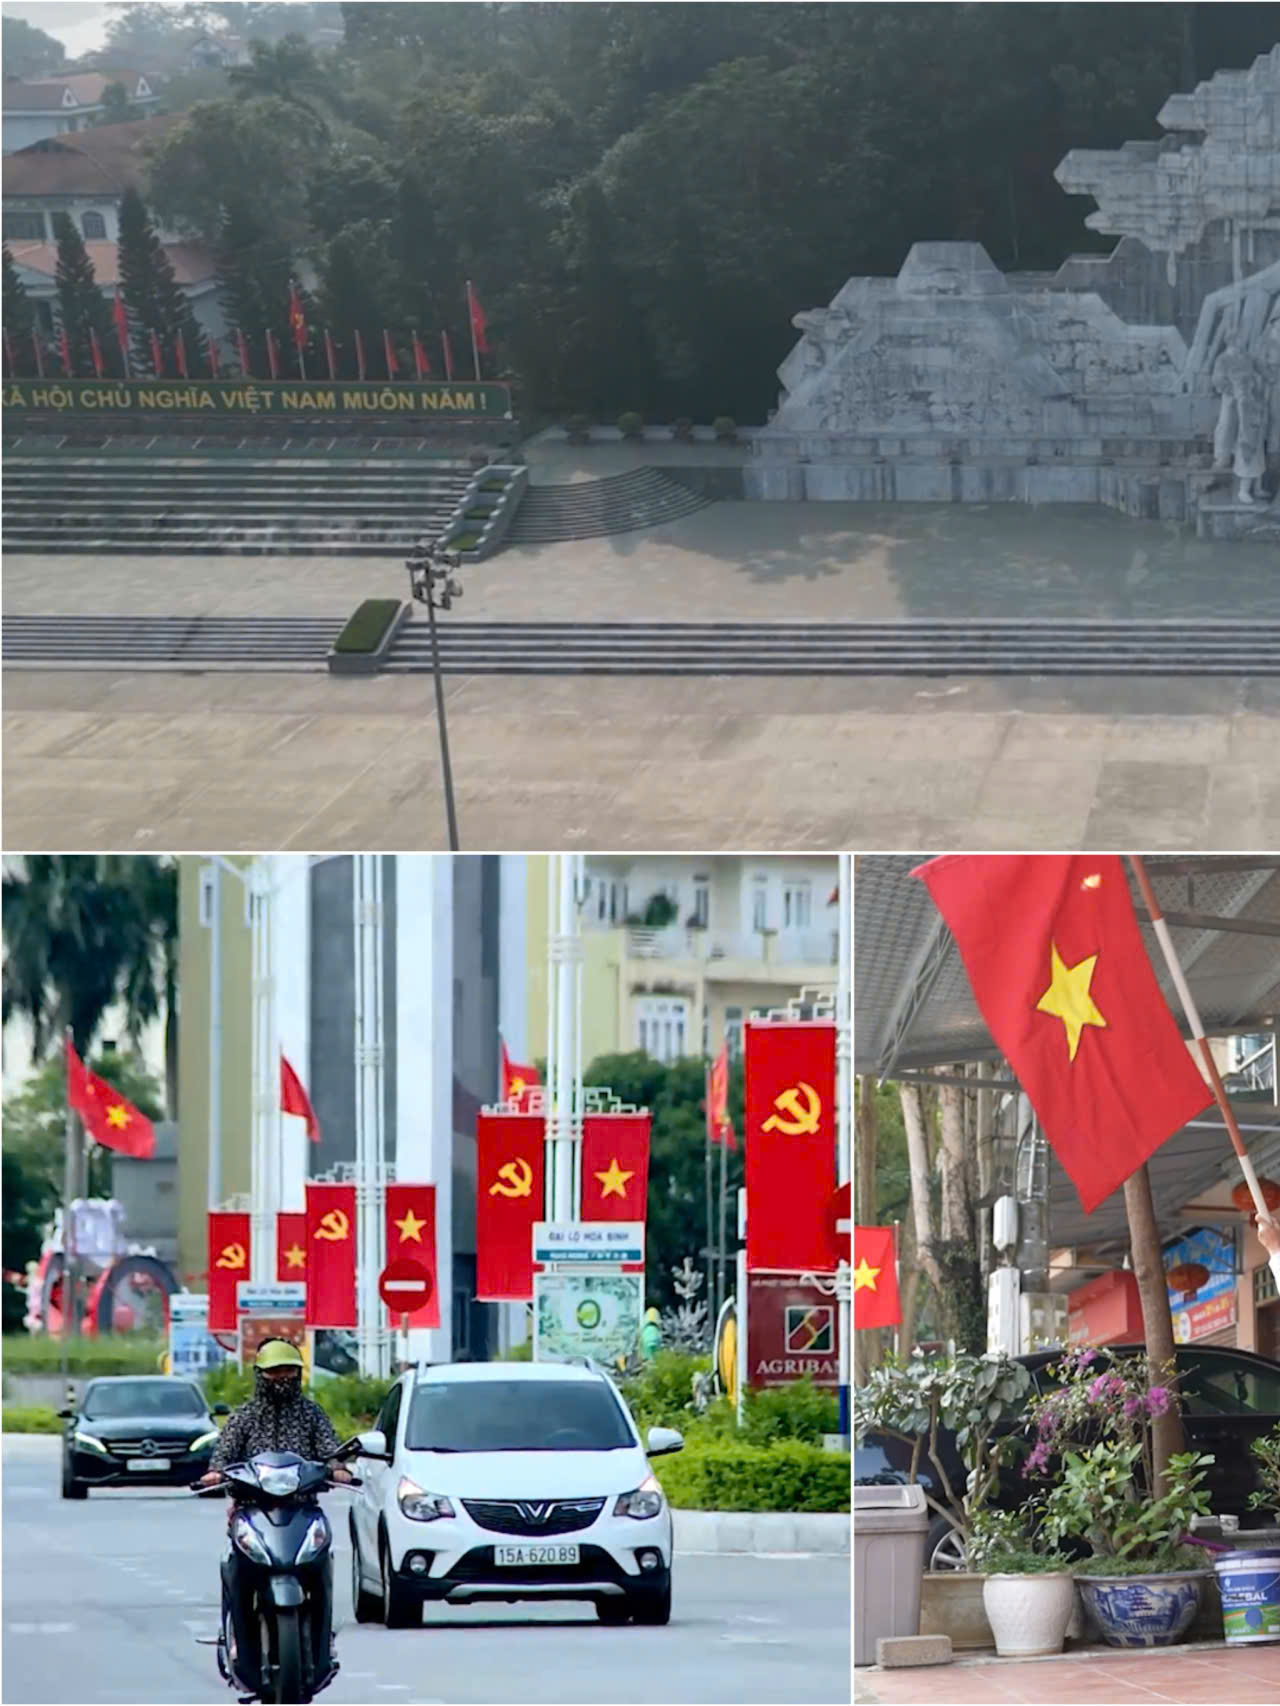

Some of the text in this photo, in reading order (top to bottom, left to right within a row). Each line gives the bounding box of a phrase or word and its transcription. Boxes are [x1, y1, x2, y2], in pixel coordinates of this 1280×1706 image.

[32, 385, 73, 412] HỘI
[80, 382, 131, 409] CHỦ
[139, 386, 216, 410] NGHĨA
[220, 386, 274, 414] VIỆT
[281, 391, 337, 410] NAM
[343, 388, 415, 411] MUÔN
[422, 387, 475, 411] NĂM
[480, 392, 487, 411] !
